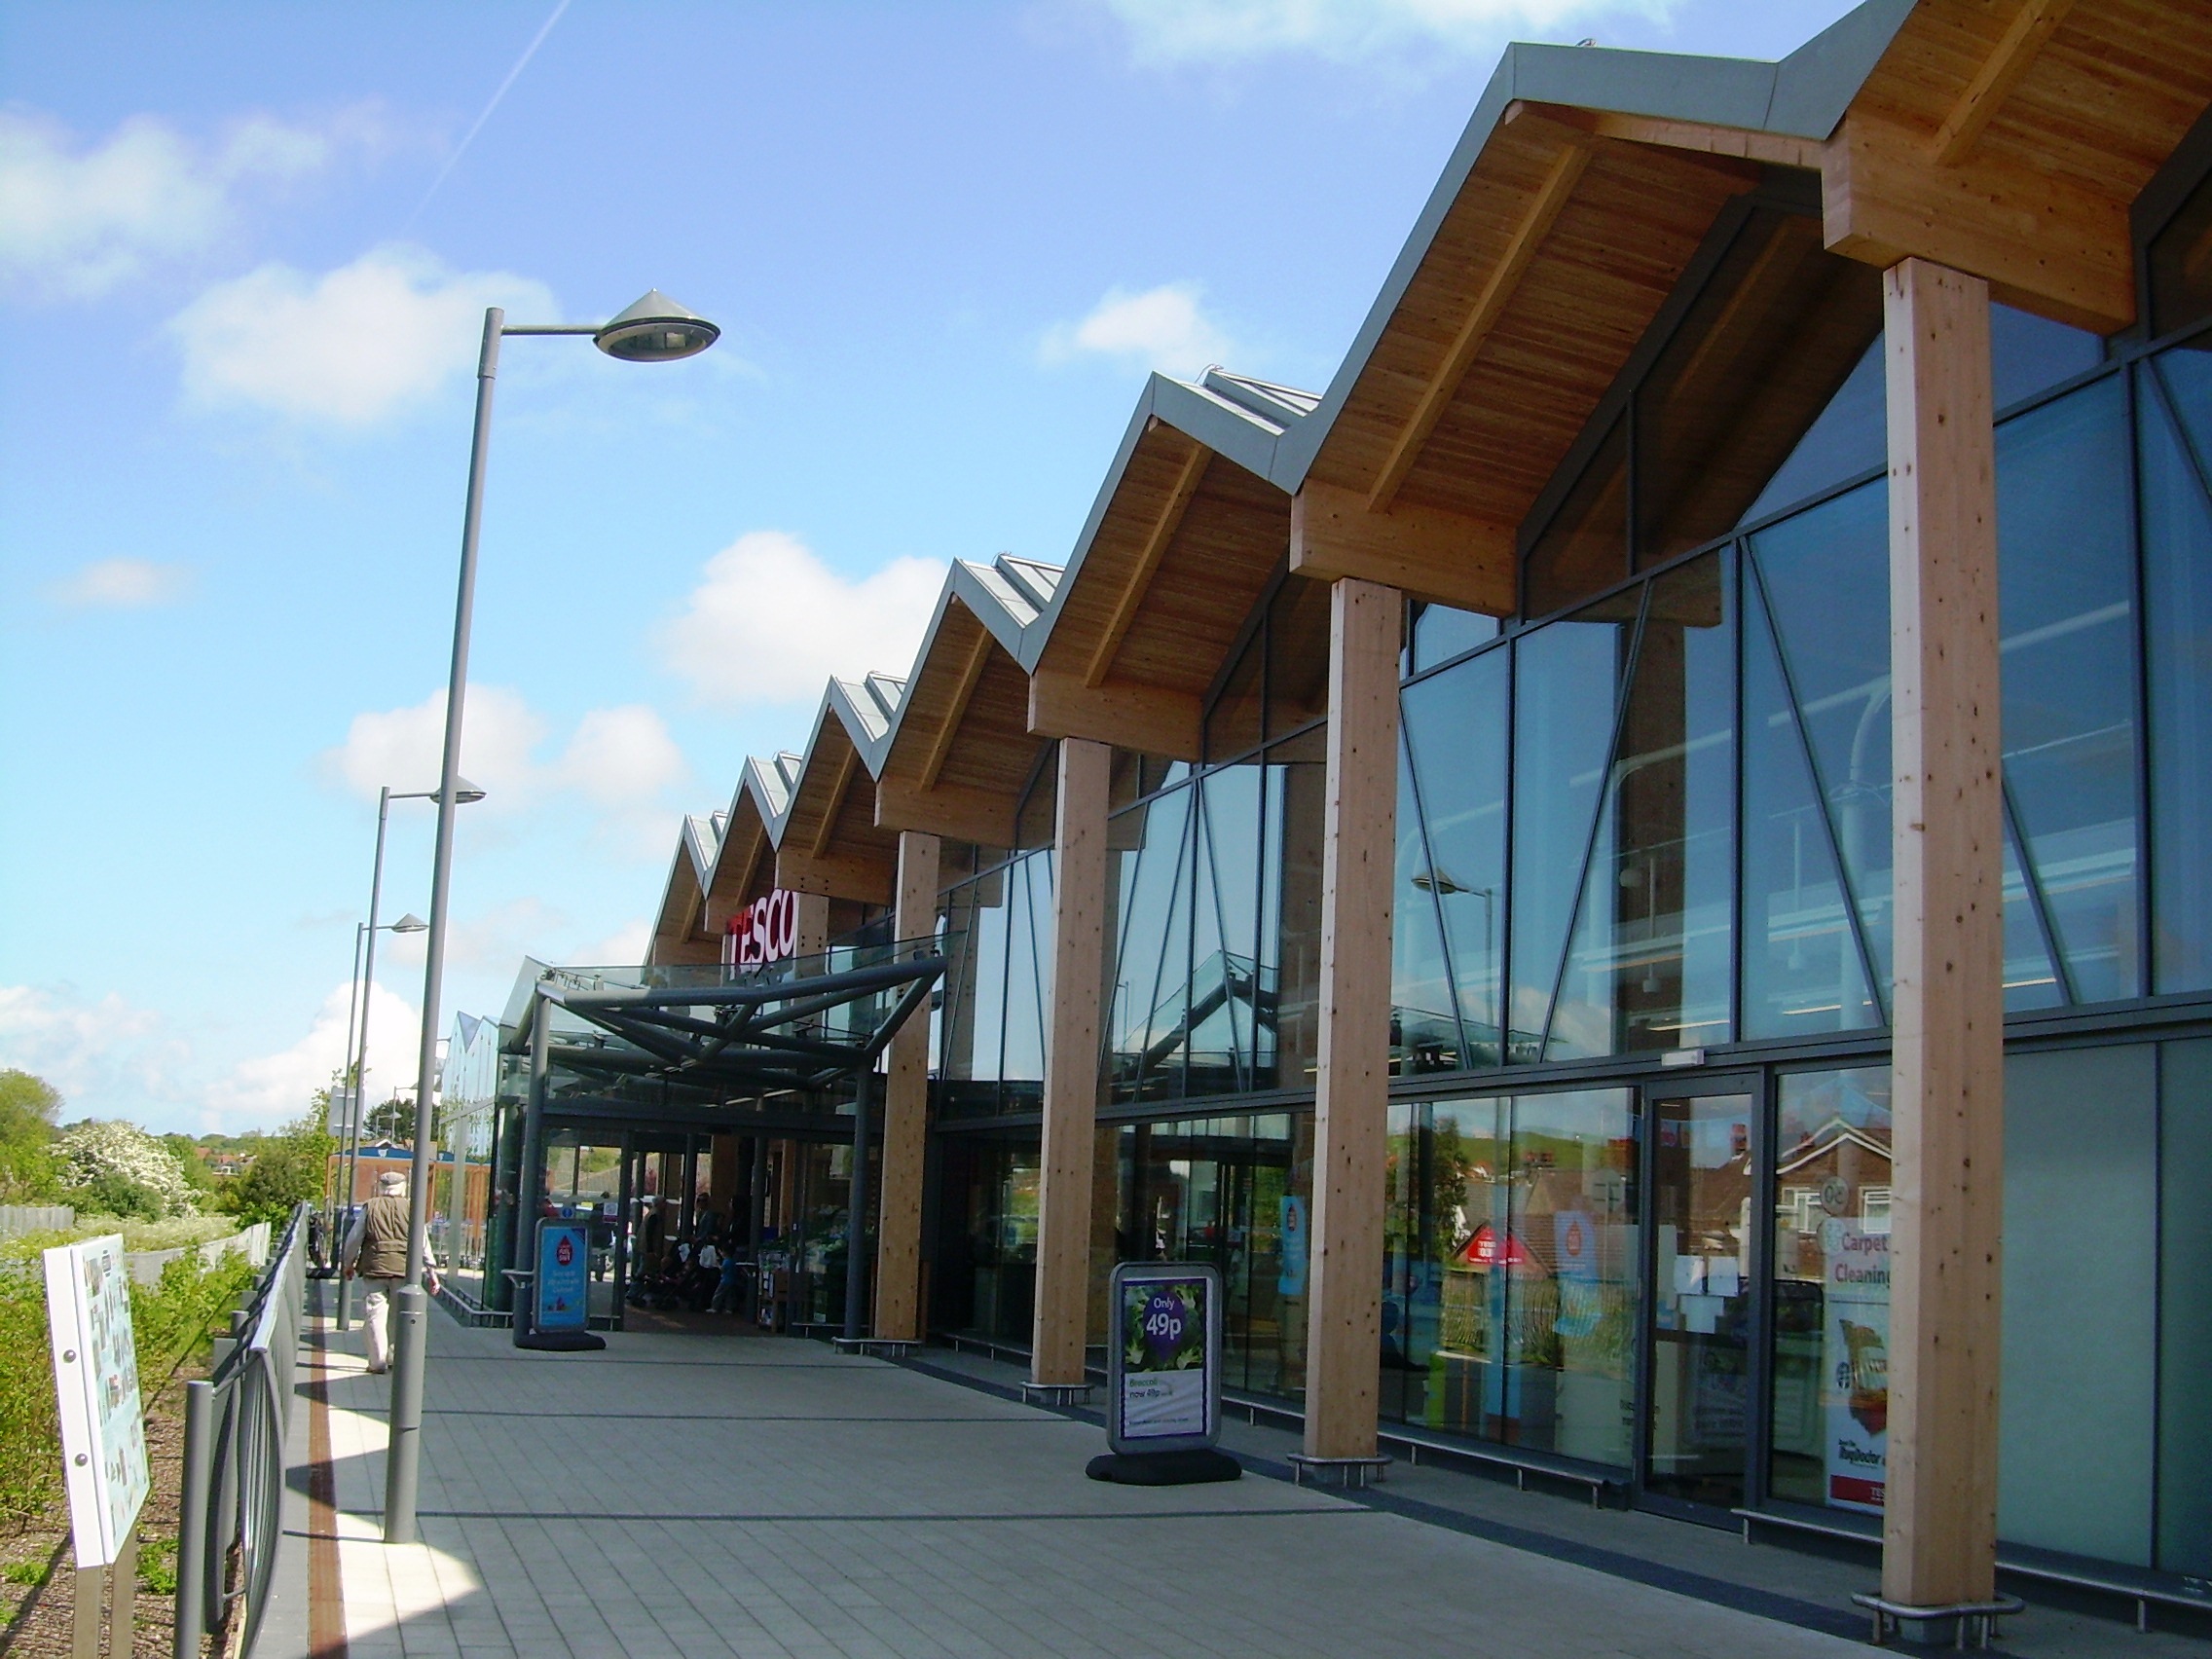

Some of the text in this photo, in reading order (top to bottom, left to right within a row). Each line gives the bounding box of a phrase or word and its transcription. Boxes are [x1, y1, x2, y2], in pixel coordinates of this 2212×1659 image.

[728, 889, 798, 980] TESCO
[1842, 1232, 1889, 1255] Carpet
[1153, 1296, 1176, 1311] Only
[1146, 1312, 1182, 1341] 49p
